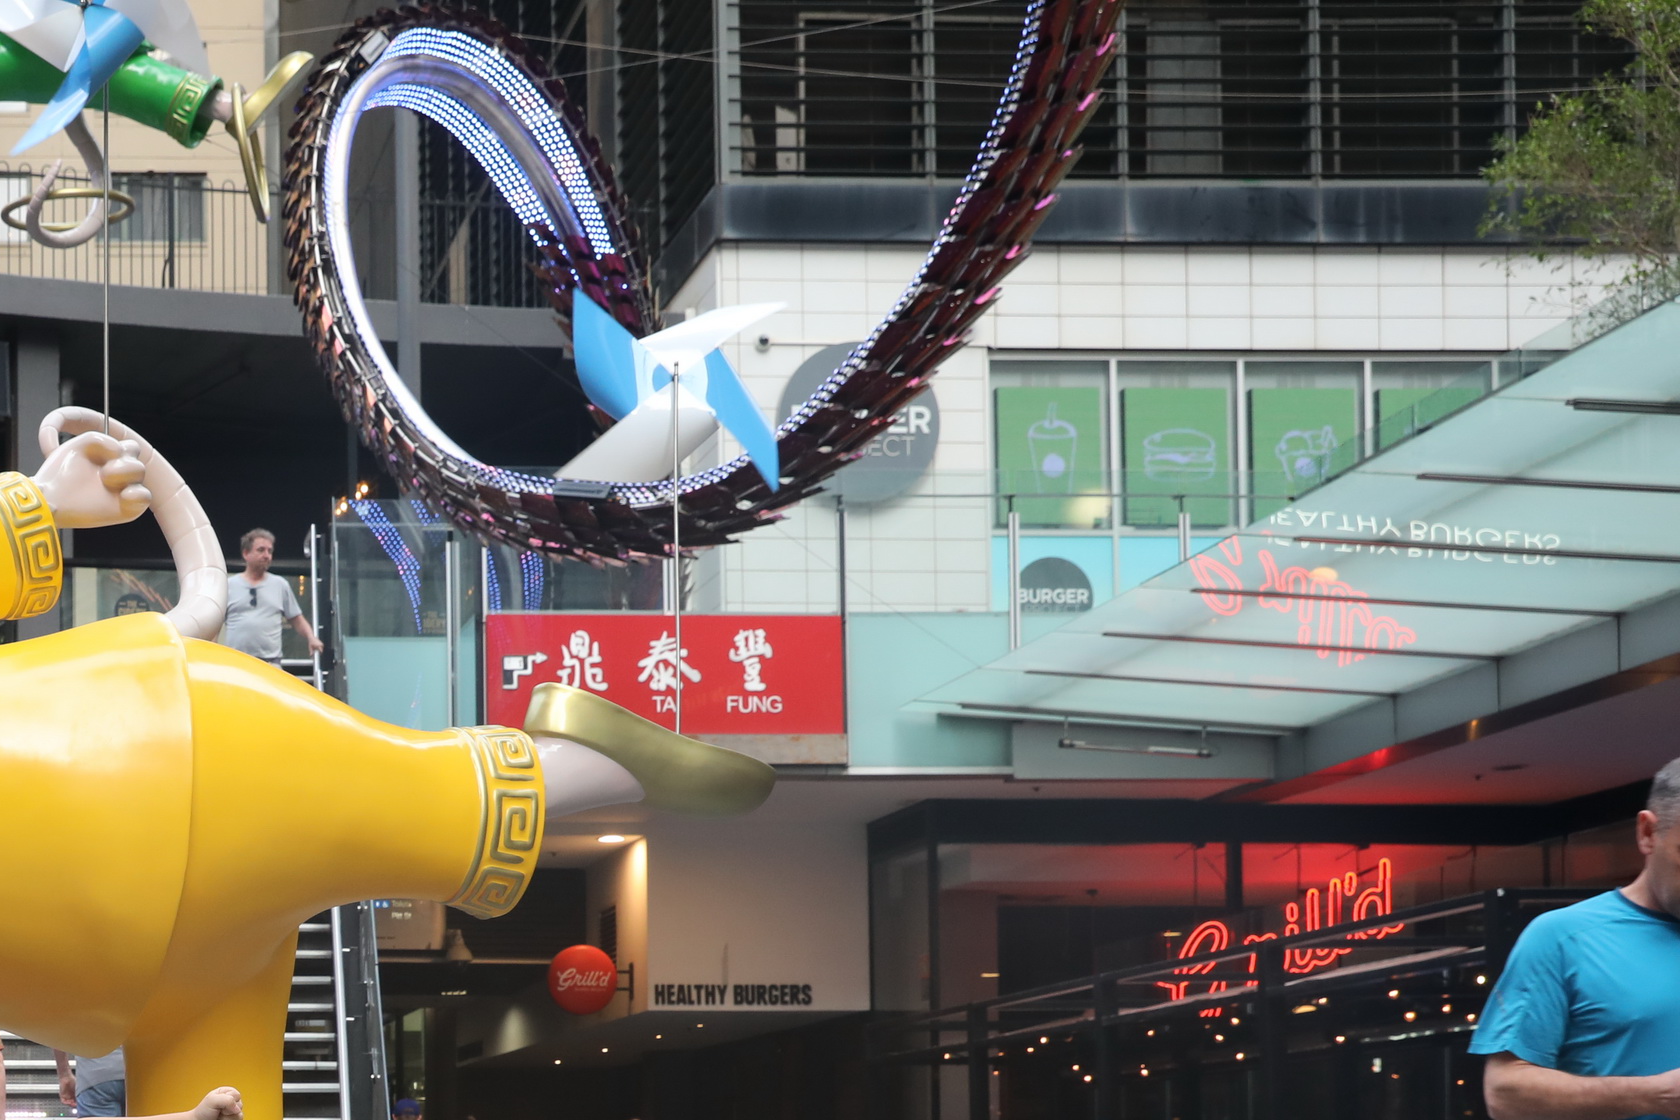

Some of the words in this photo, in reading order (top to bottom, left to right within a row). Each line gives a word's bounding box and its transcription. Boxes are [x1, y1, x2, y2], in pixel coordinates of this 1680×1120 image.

[1020, 588, 1089, 603] BURGER
[727, 695, 783, 714] FUNG
[557, 968, 612, 991] Grill'd
[654, 984, 727, 1006] HEALTHY
[733, 984, 813, 1006] BURGERS
